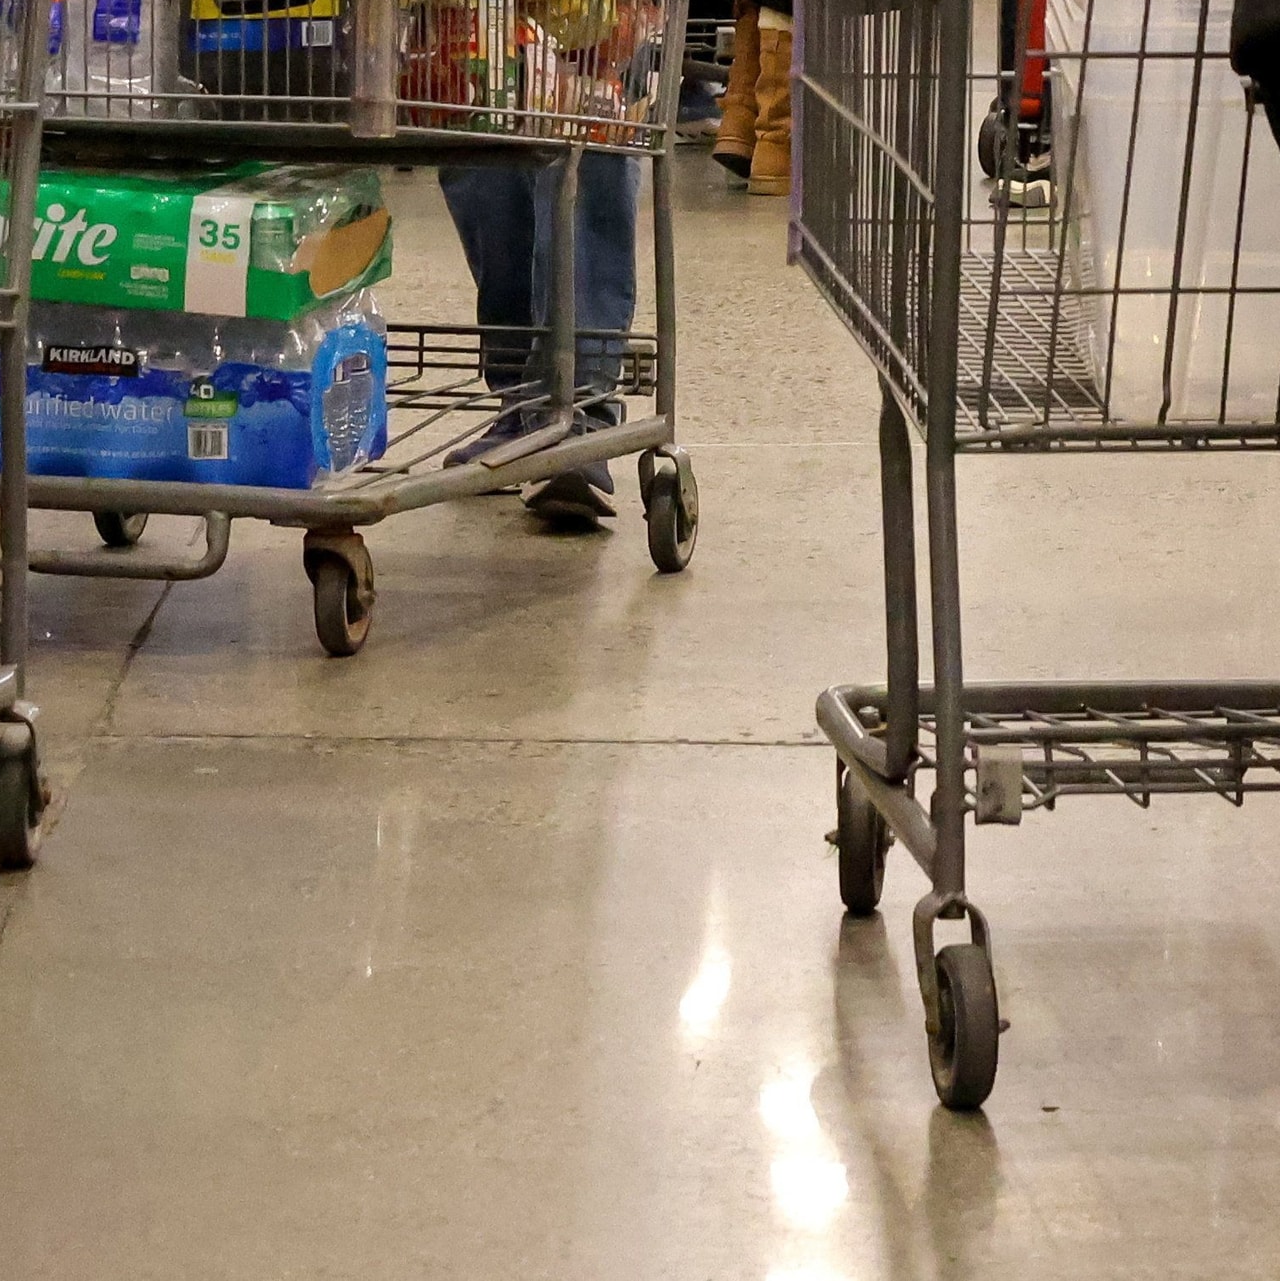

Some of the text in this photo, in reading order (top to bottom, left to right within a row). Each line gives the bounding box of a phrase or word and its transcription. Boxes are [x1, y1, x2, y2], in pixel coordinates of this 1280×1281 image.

[199, 219, 241, 250] 35
[49, 347, 136, 366] KIRKLAND
[190, 384, 214, 399] 40
[101, 402, 173, 422] water
